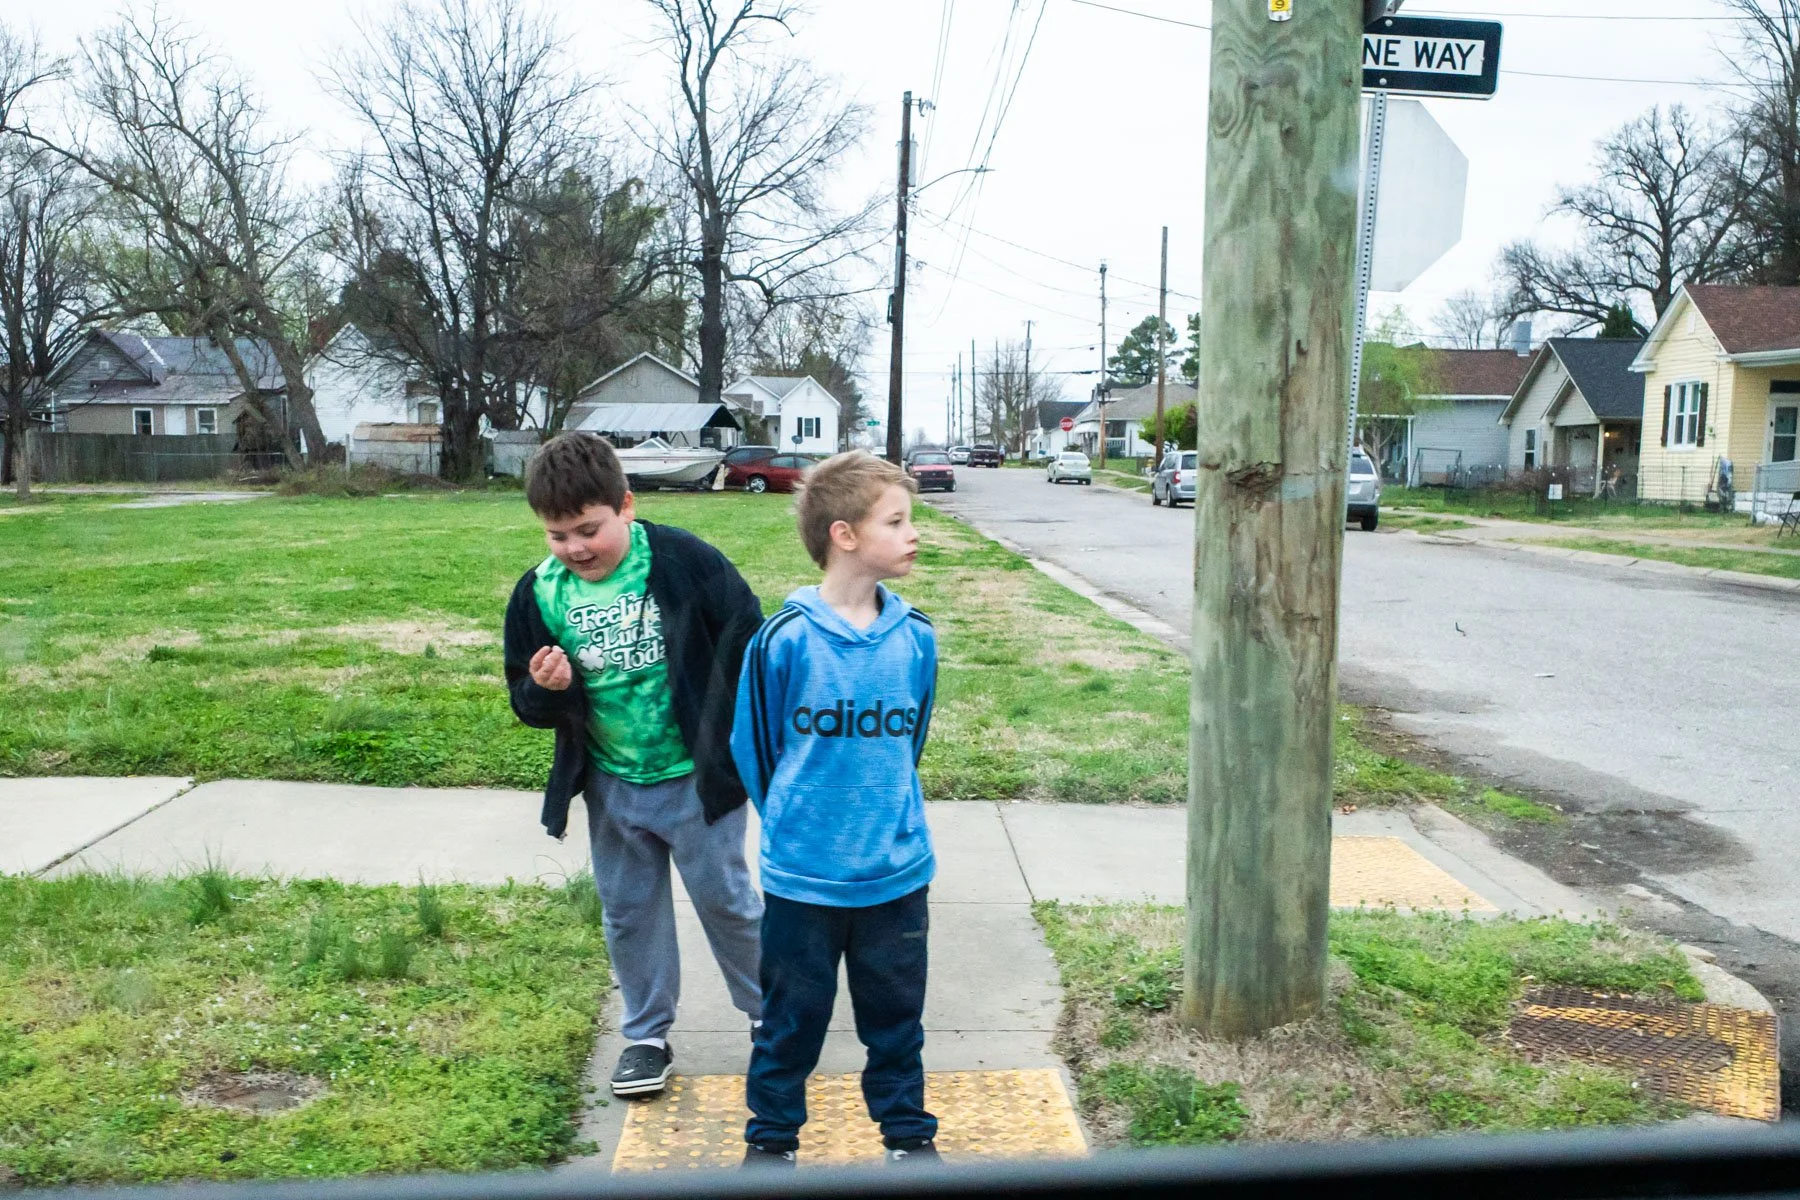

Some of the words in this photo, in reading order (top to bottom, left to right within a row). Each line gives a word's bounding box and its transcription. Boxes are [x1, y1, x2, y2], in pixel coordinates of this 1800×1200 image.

[1363, 38, 1401, 67] NE
[1414, 41, 1476, 70] WAY
[591, 619, 661, 651] Luck
[793, 700, 917, 738] adidas
